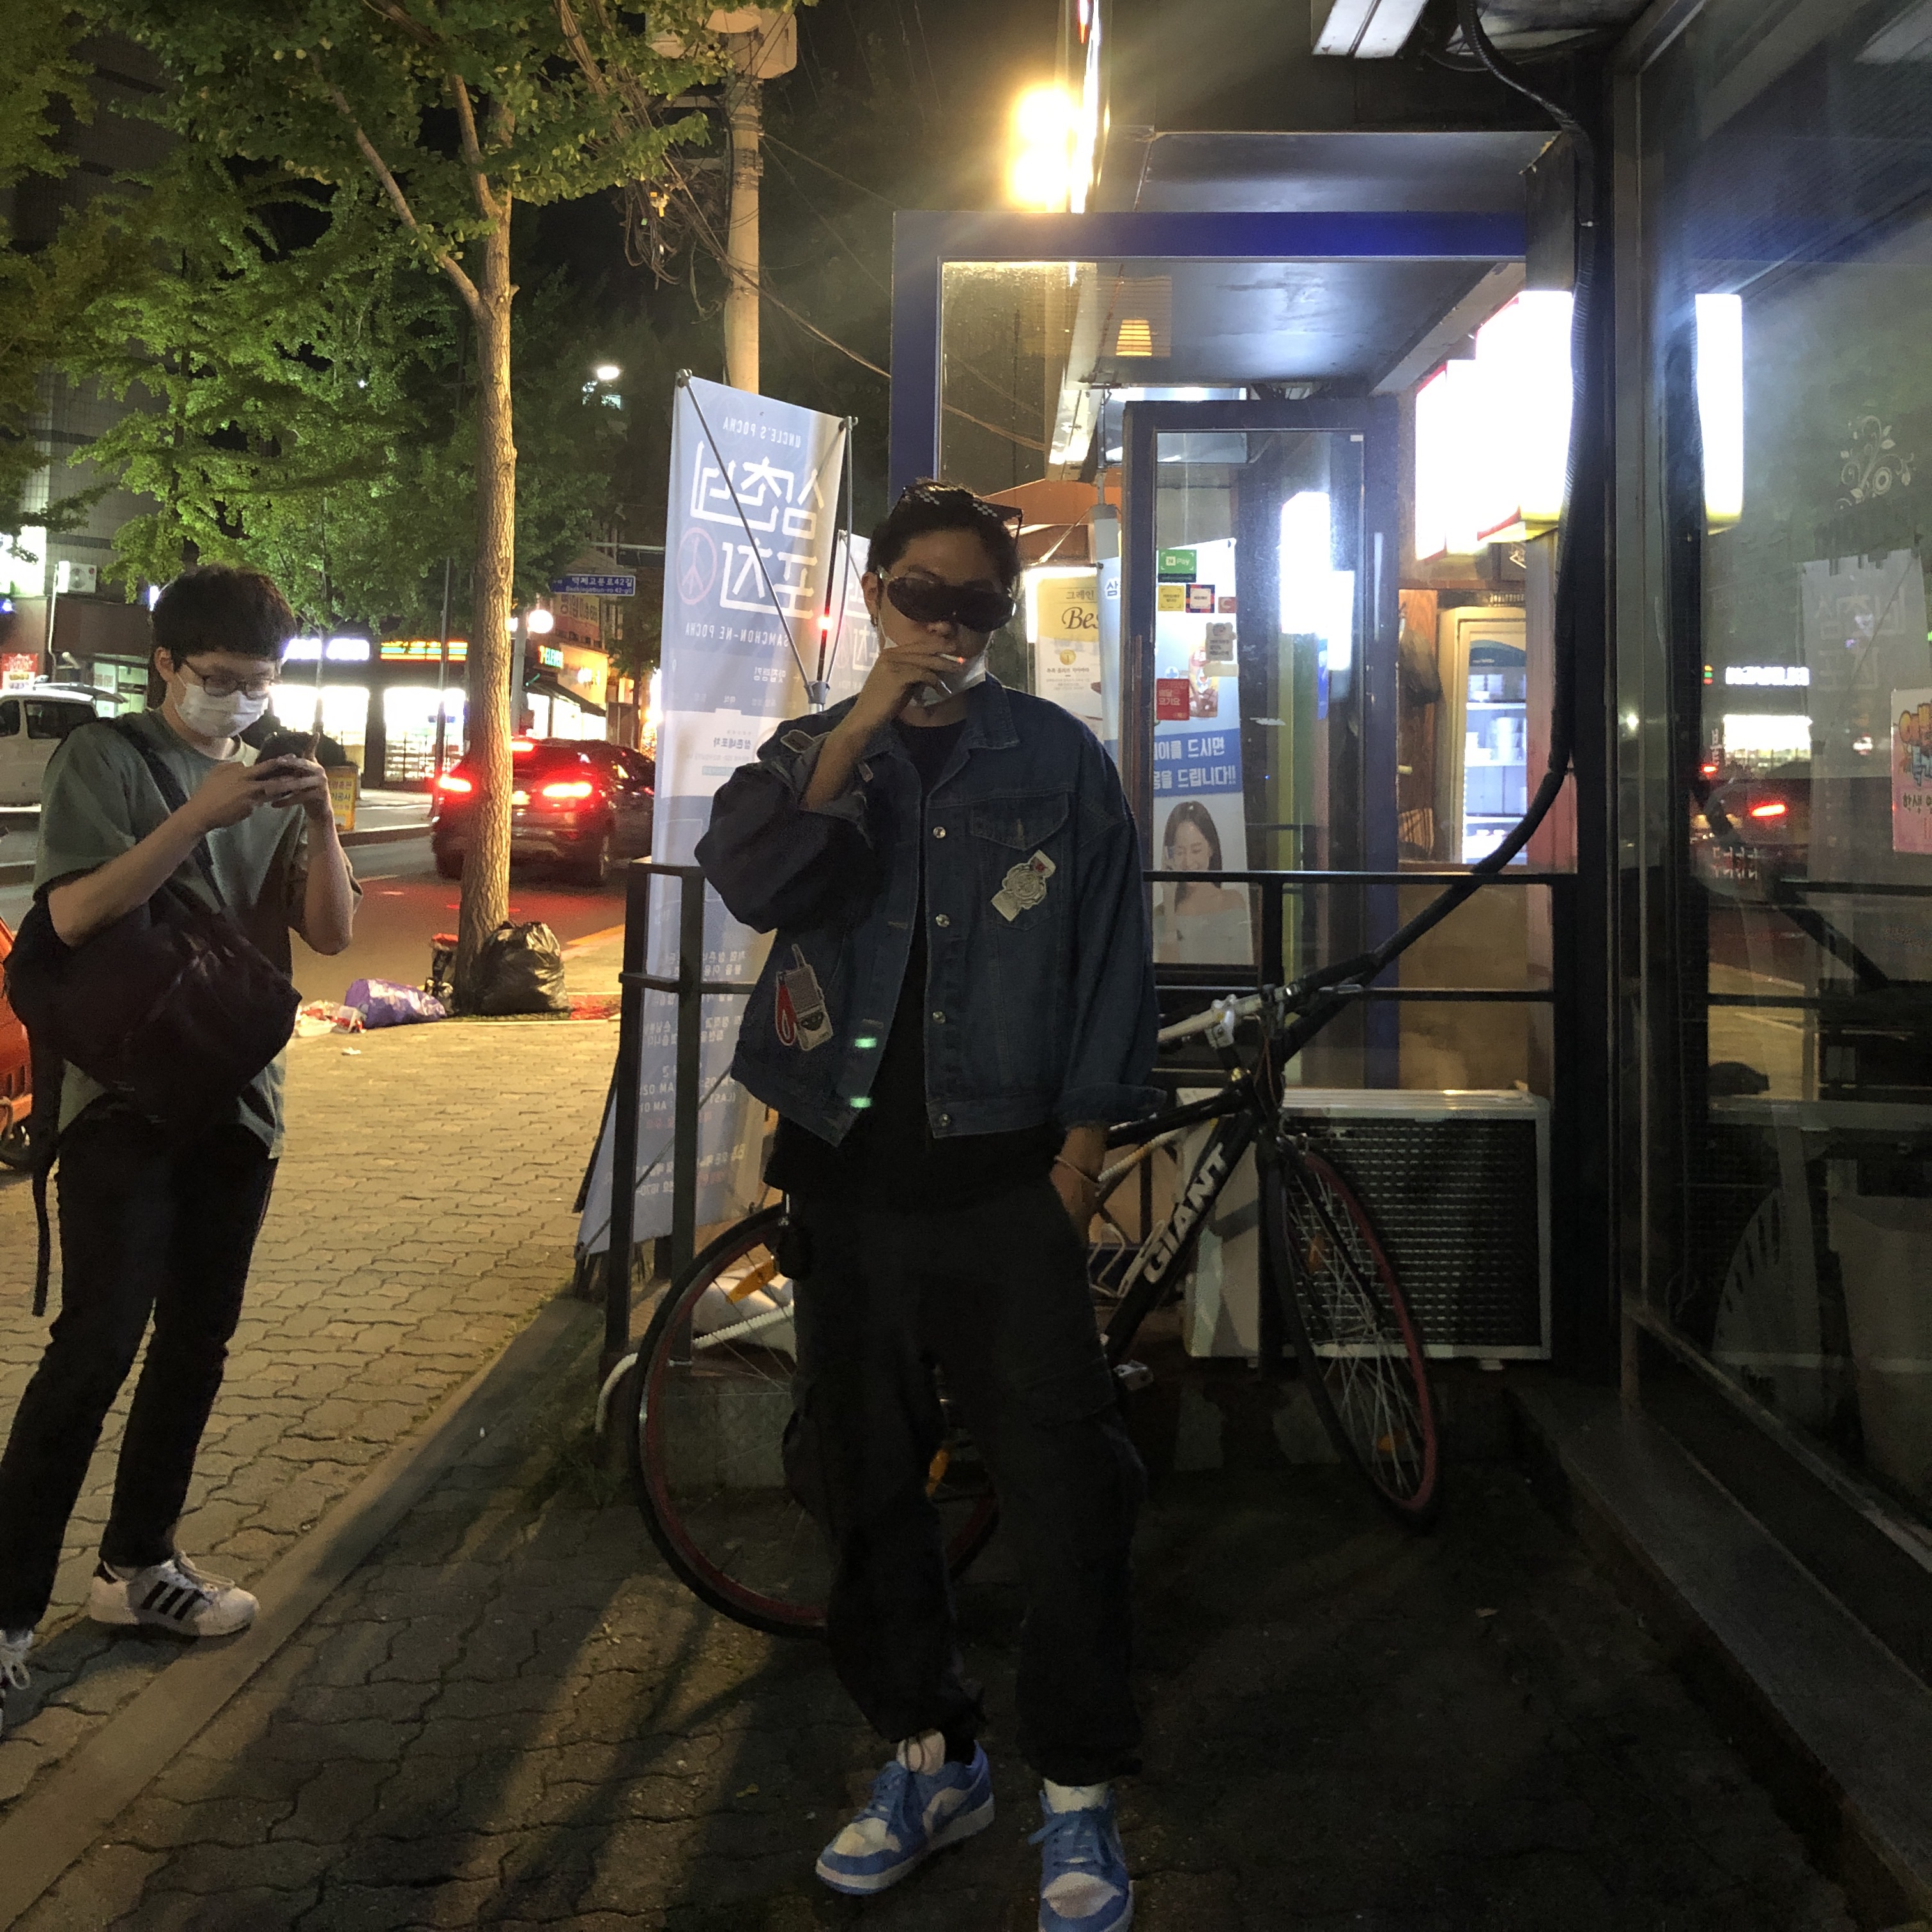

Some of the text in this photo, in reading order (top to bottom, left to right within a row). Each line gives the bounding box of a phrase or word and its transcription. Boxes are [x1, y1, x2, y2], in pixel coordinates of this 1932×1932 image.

[1177, 558, 1190, 566] Pay
[1158, 698, 1181, 706] 요기요
[1154, 736, 1225, 760] 이를 드시면
[1177, 765, 1237, 788] 드립니다!!
[1143, 1141, 1228, 1284] GIANT
